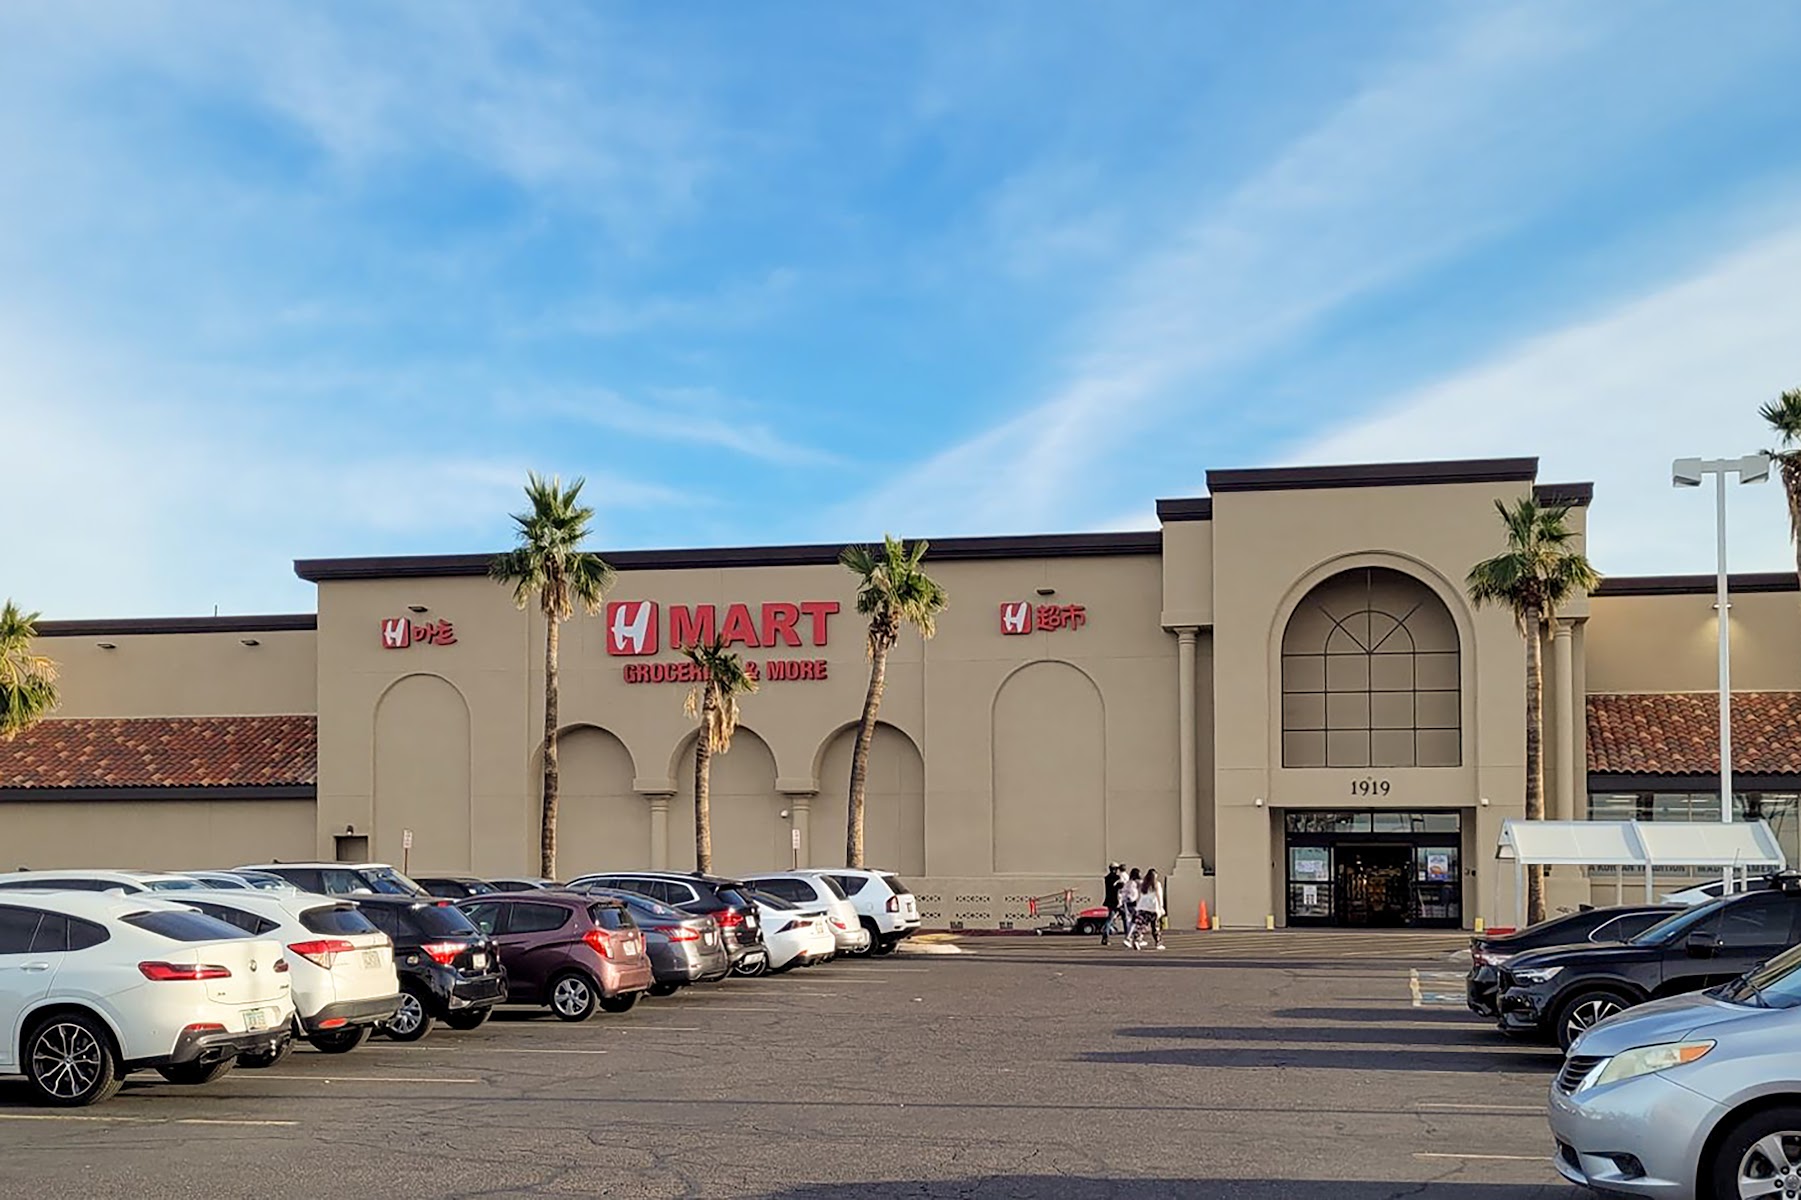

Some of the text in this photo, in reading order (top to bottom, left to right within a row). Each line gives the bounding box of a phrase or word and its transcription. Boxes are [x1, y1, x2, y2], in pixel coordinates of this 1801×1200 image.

[384, 617, 458, 647] H 마트
[611, 600, 840, 654] H MART
[1003, 602, 1086, 633] H 超市
[744, 660, 760, 681] &
[766, 659, 828, 681] MORE
[1351, 780, 1391, 796] 1919
